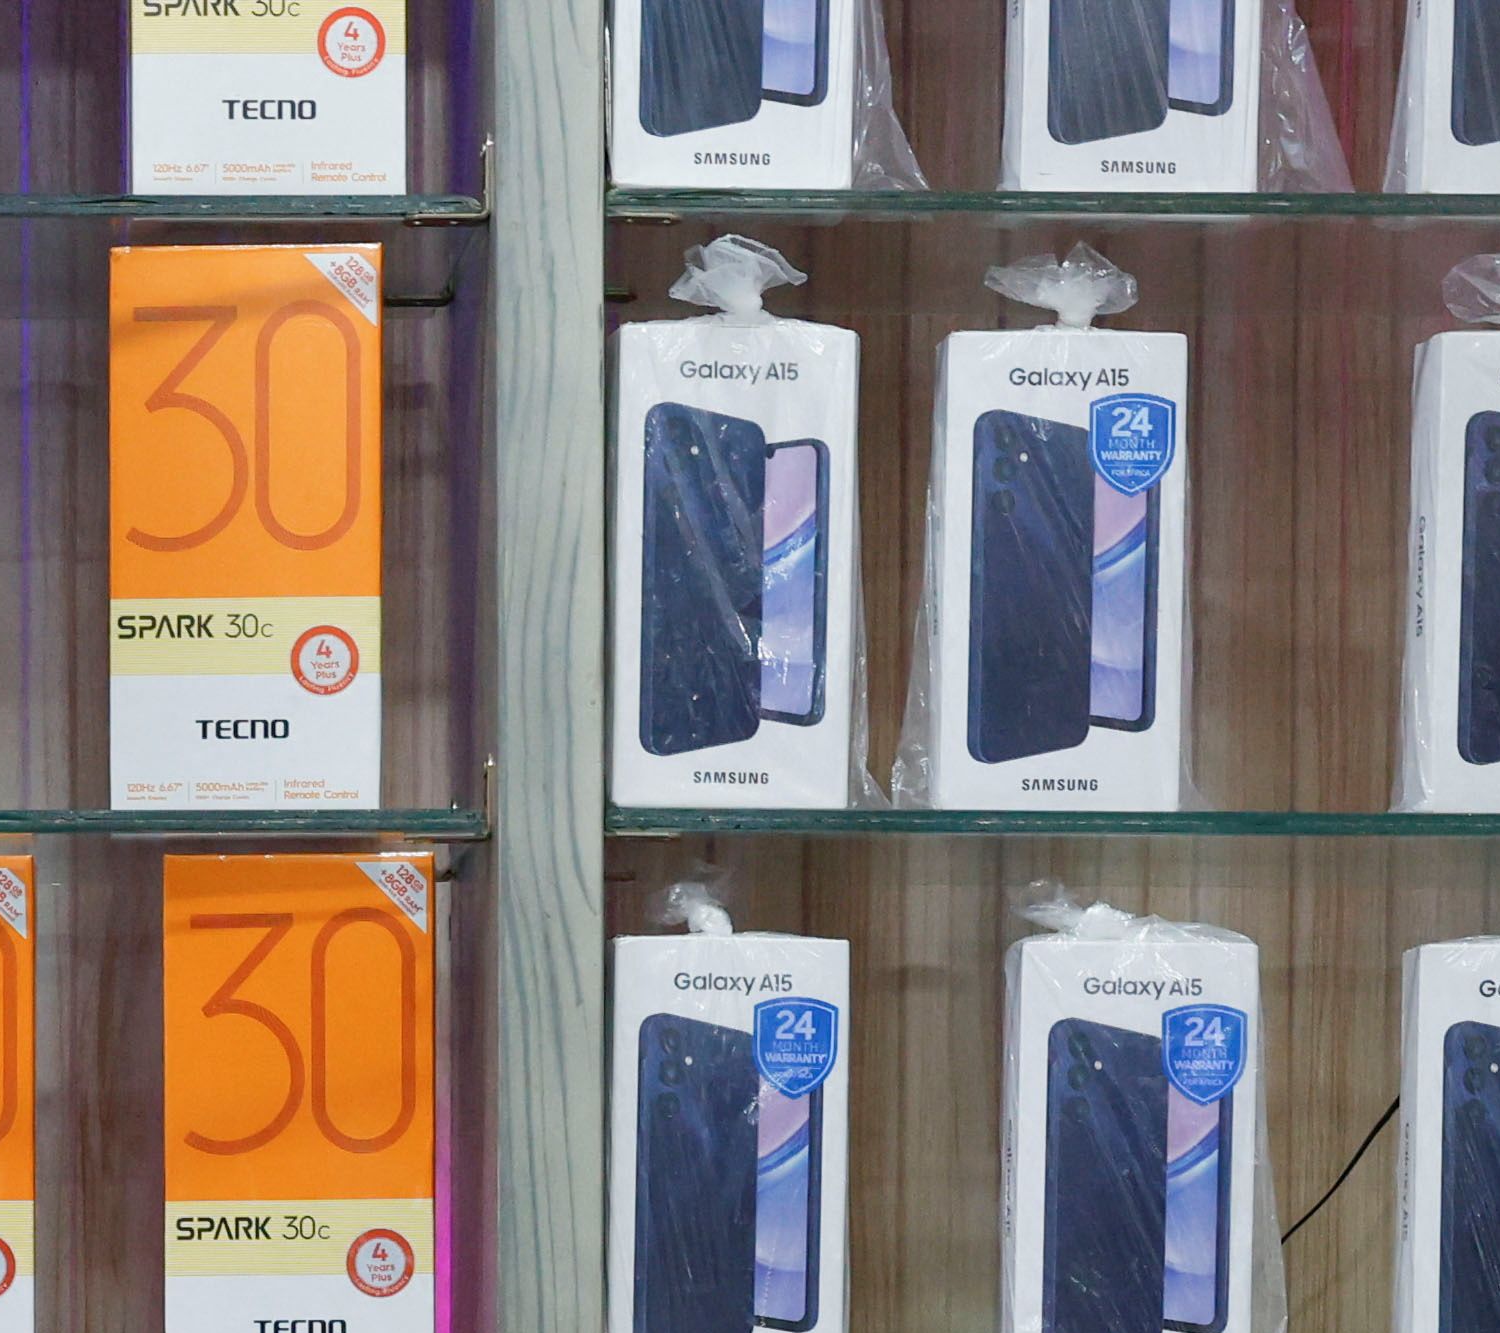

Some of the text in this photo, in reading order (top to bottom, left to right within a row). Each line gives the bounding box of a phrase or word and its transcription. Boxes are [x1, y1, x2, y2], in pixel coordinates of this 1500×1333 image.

[222, 100, 316, 120] TECNO
[694, 152, 770, 166] SAMSUNG
[126, 299, 362, 552] 30
[118, 615, 214, 640] SPARK
[196, 719, 290, 740] TECNO
[694, 770, 770, 784] SAMSUNG
